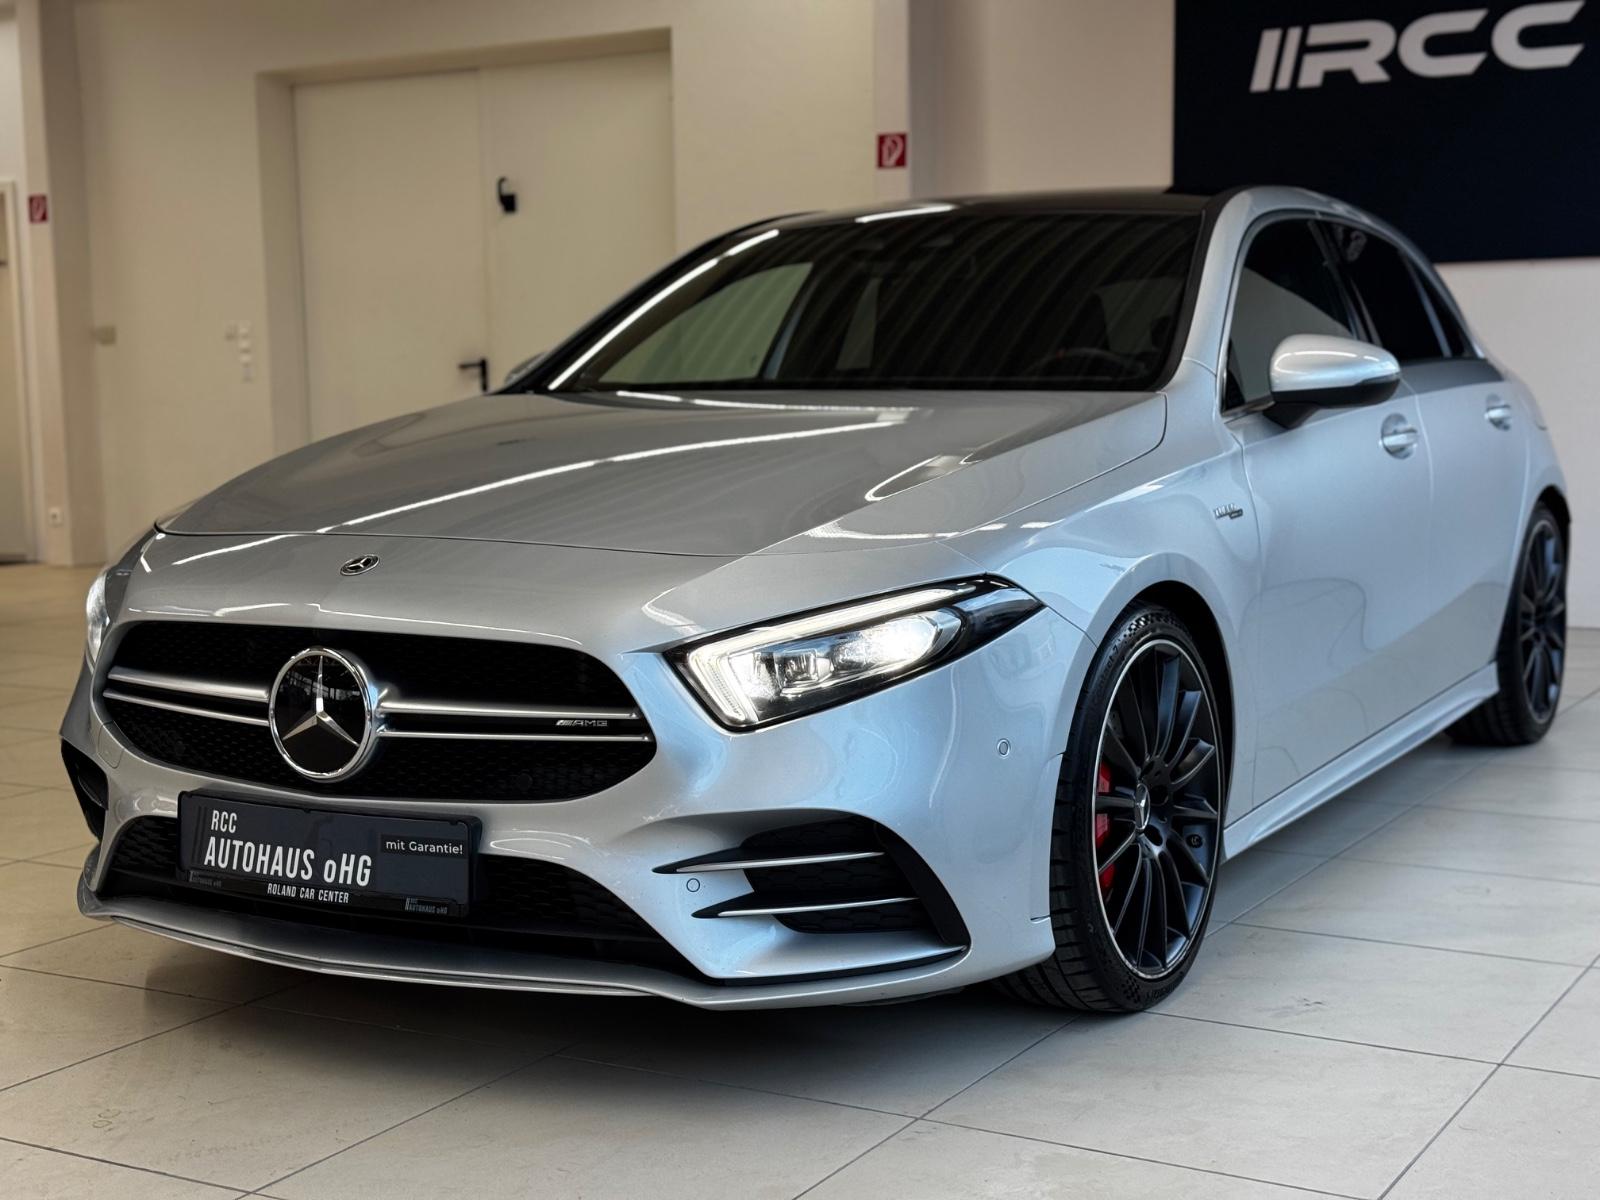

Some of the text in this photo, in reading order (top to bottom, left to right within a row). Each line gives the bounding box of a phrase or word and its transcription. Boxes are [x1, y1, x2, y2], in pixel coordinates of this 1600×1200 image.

[1296, 0, 1586, 89] RCC
[573, 719, 608, 727] AMG
[210, 809, 238, 834] RCC
[385, 839, 463, 855] mit Garantie!
[203, 835, 315, 880] AUTOHAUS
[323, 852, 372, 887] oHG
[267, 882, 349, 904] ROLAND CAR CENTER
